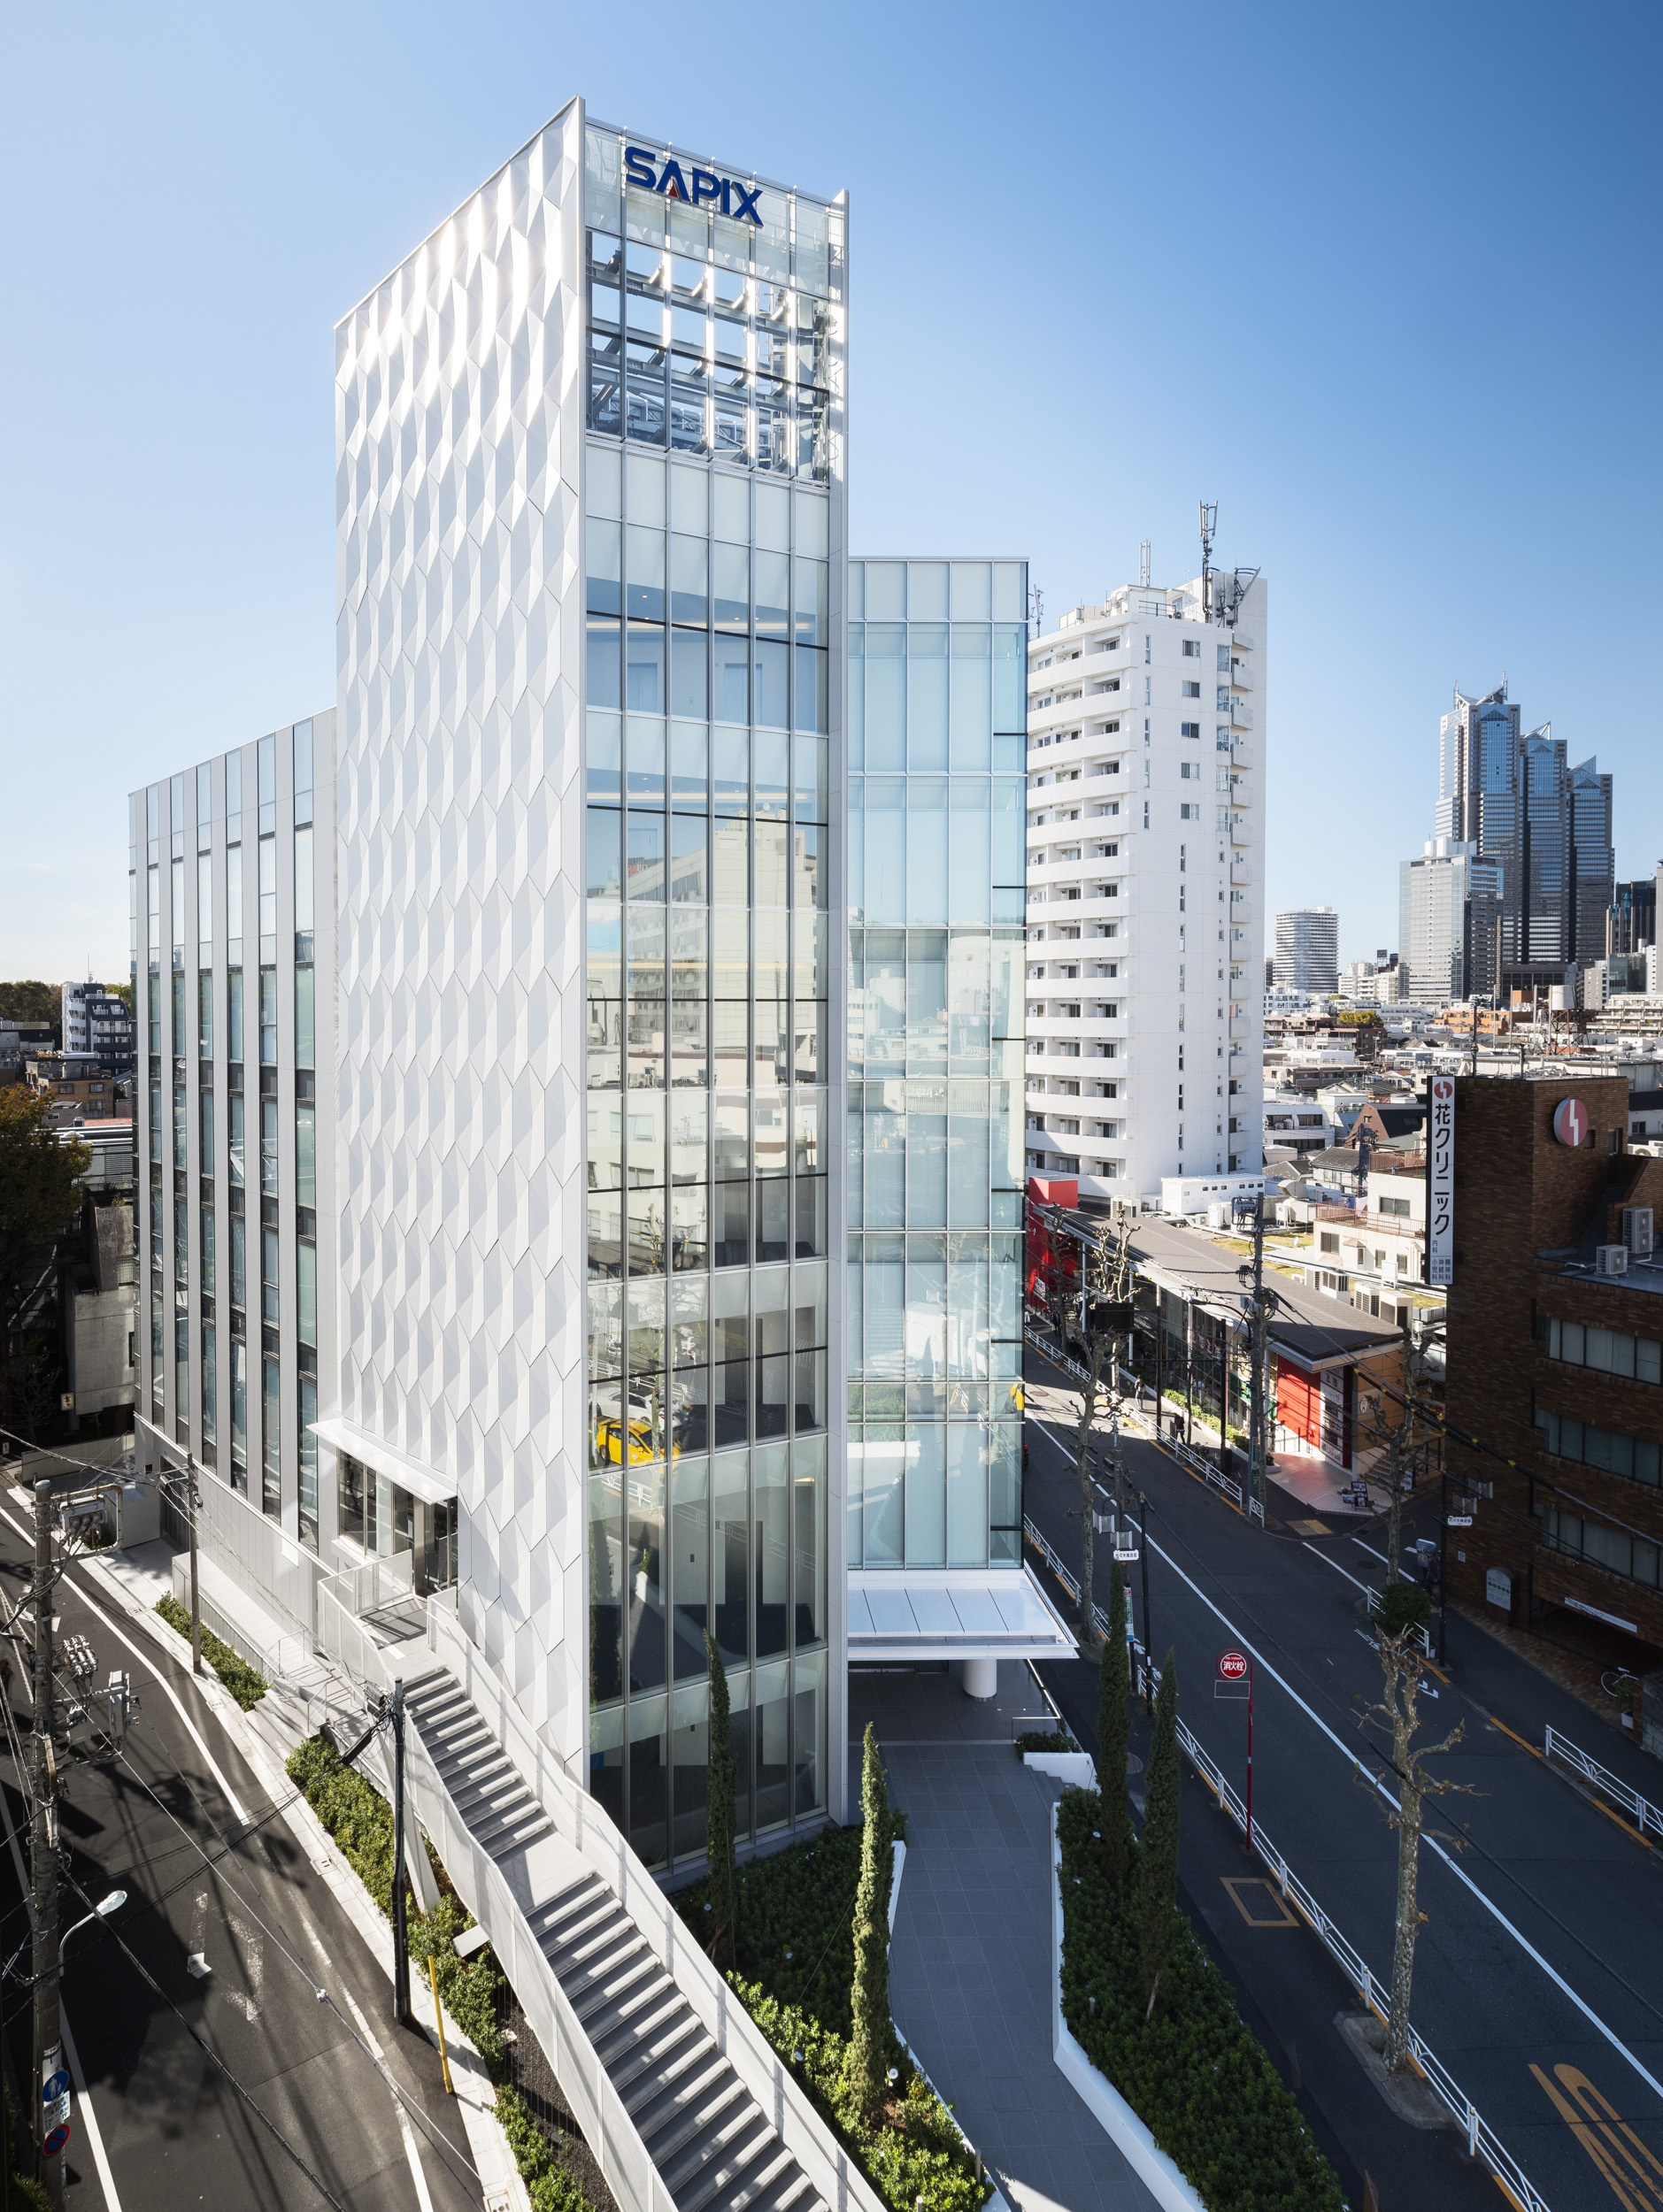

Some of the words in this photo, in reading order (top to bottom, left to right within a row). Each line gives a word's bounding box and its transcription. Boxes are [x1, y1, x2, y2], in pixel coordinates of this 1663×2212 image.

[624, 146, 764, 227] SAPIX
[1435, 1103, 1451, 1235] 花クリニック
[1432, 1240, 1437, 1254] 内科
[1223, 1661, 1244, 1671] 消火栓
